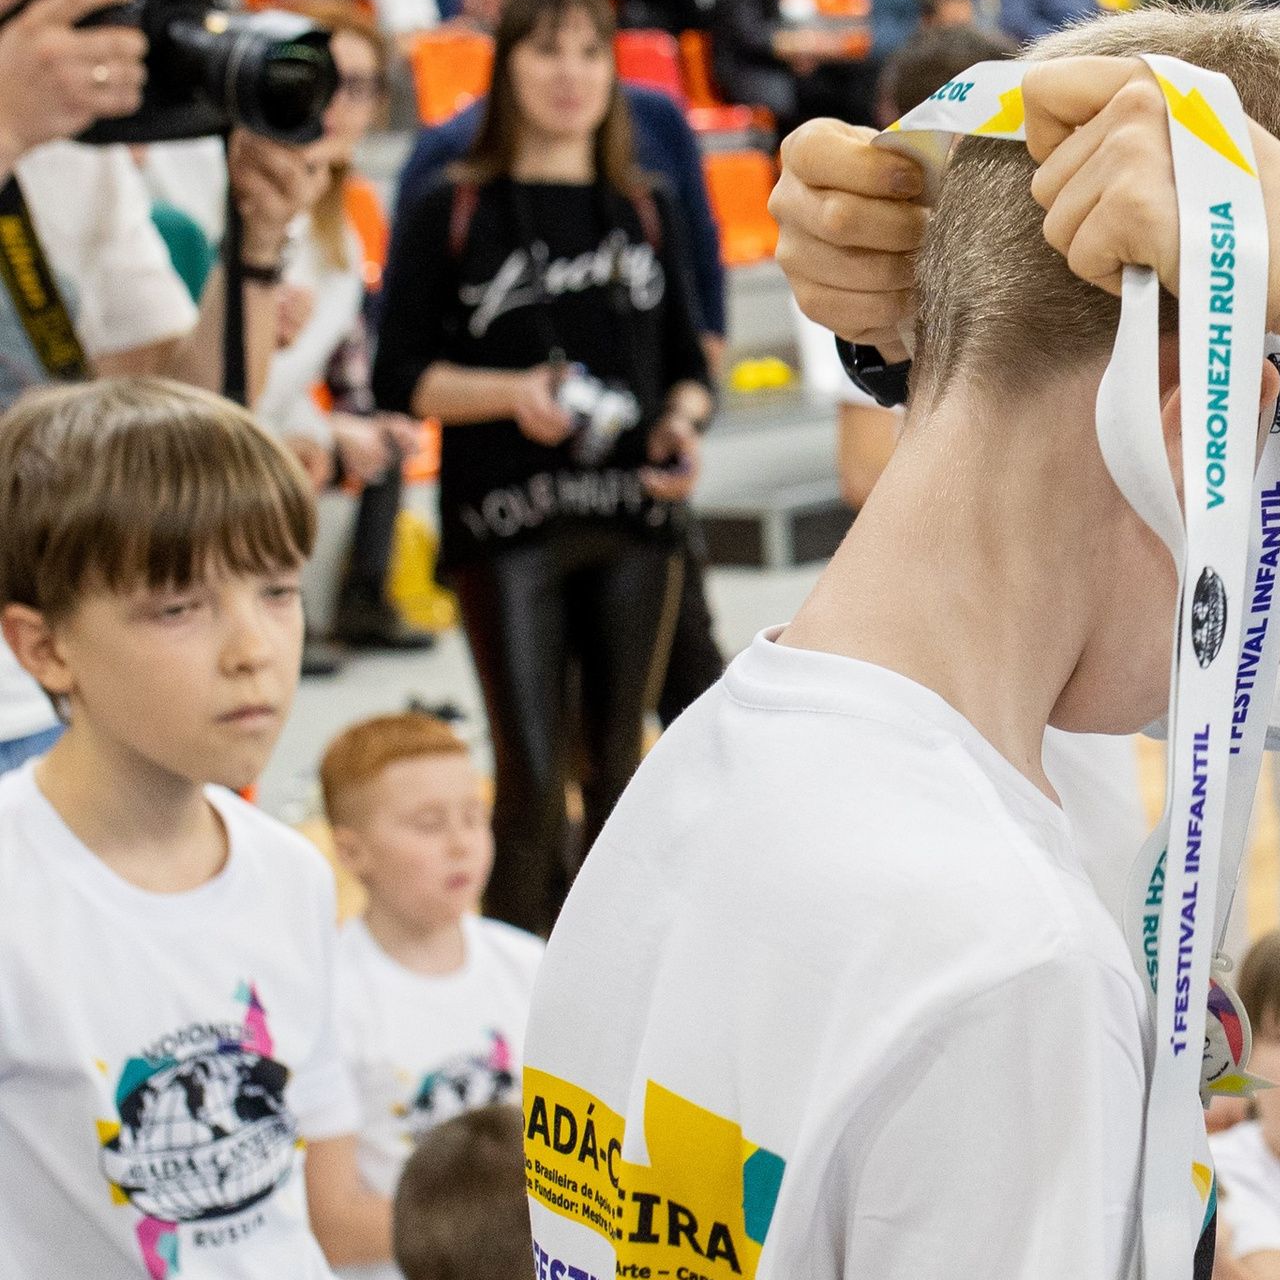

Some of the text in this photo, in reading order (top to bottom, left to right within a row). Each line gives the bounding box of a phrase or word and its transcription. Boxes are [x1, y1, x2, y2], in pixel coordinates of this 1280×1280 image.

[1206, 202, 1236, 510] VORONEZH RUSSIA
[1231, 618, 1268, 739] FESTIVAL
[1184, 724, 1210, 873] INFANTIL
[1174, 881, 1198, 1033] FESTIVAL
[522, 1095, 622, 1189] ADÁ-C
[535, 1159, 578, 1193] Brasileira
[581, 1182, 593, 1200] de
[535, 1178, 578, 1214] Fundador:
